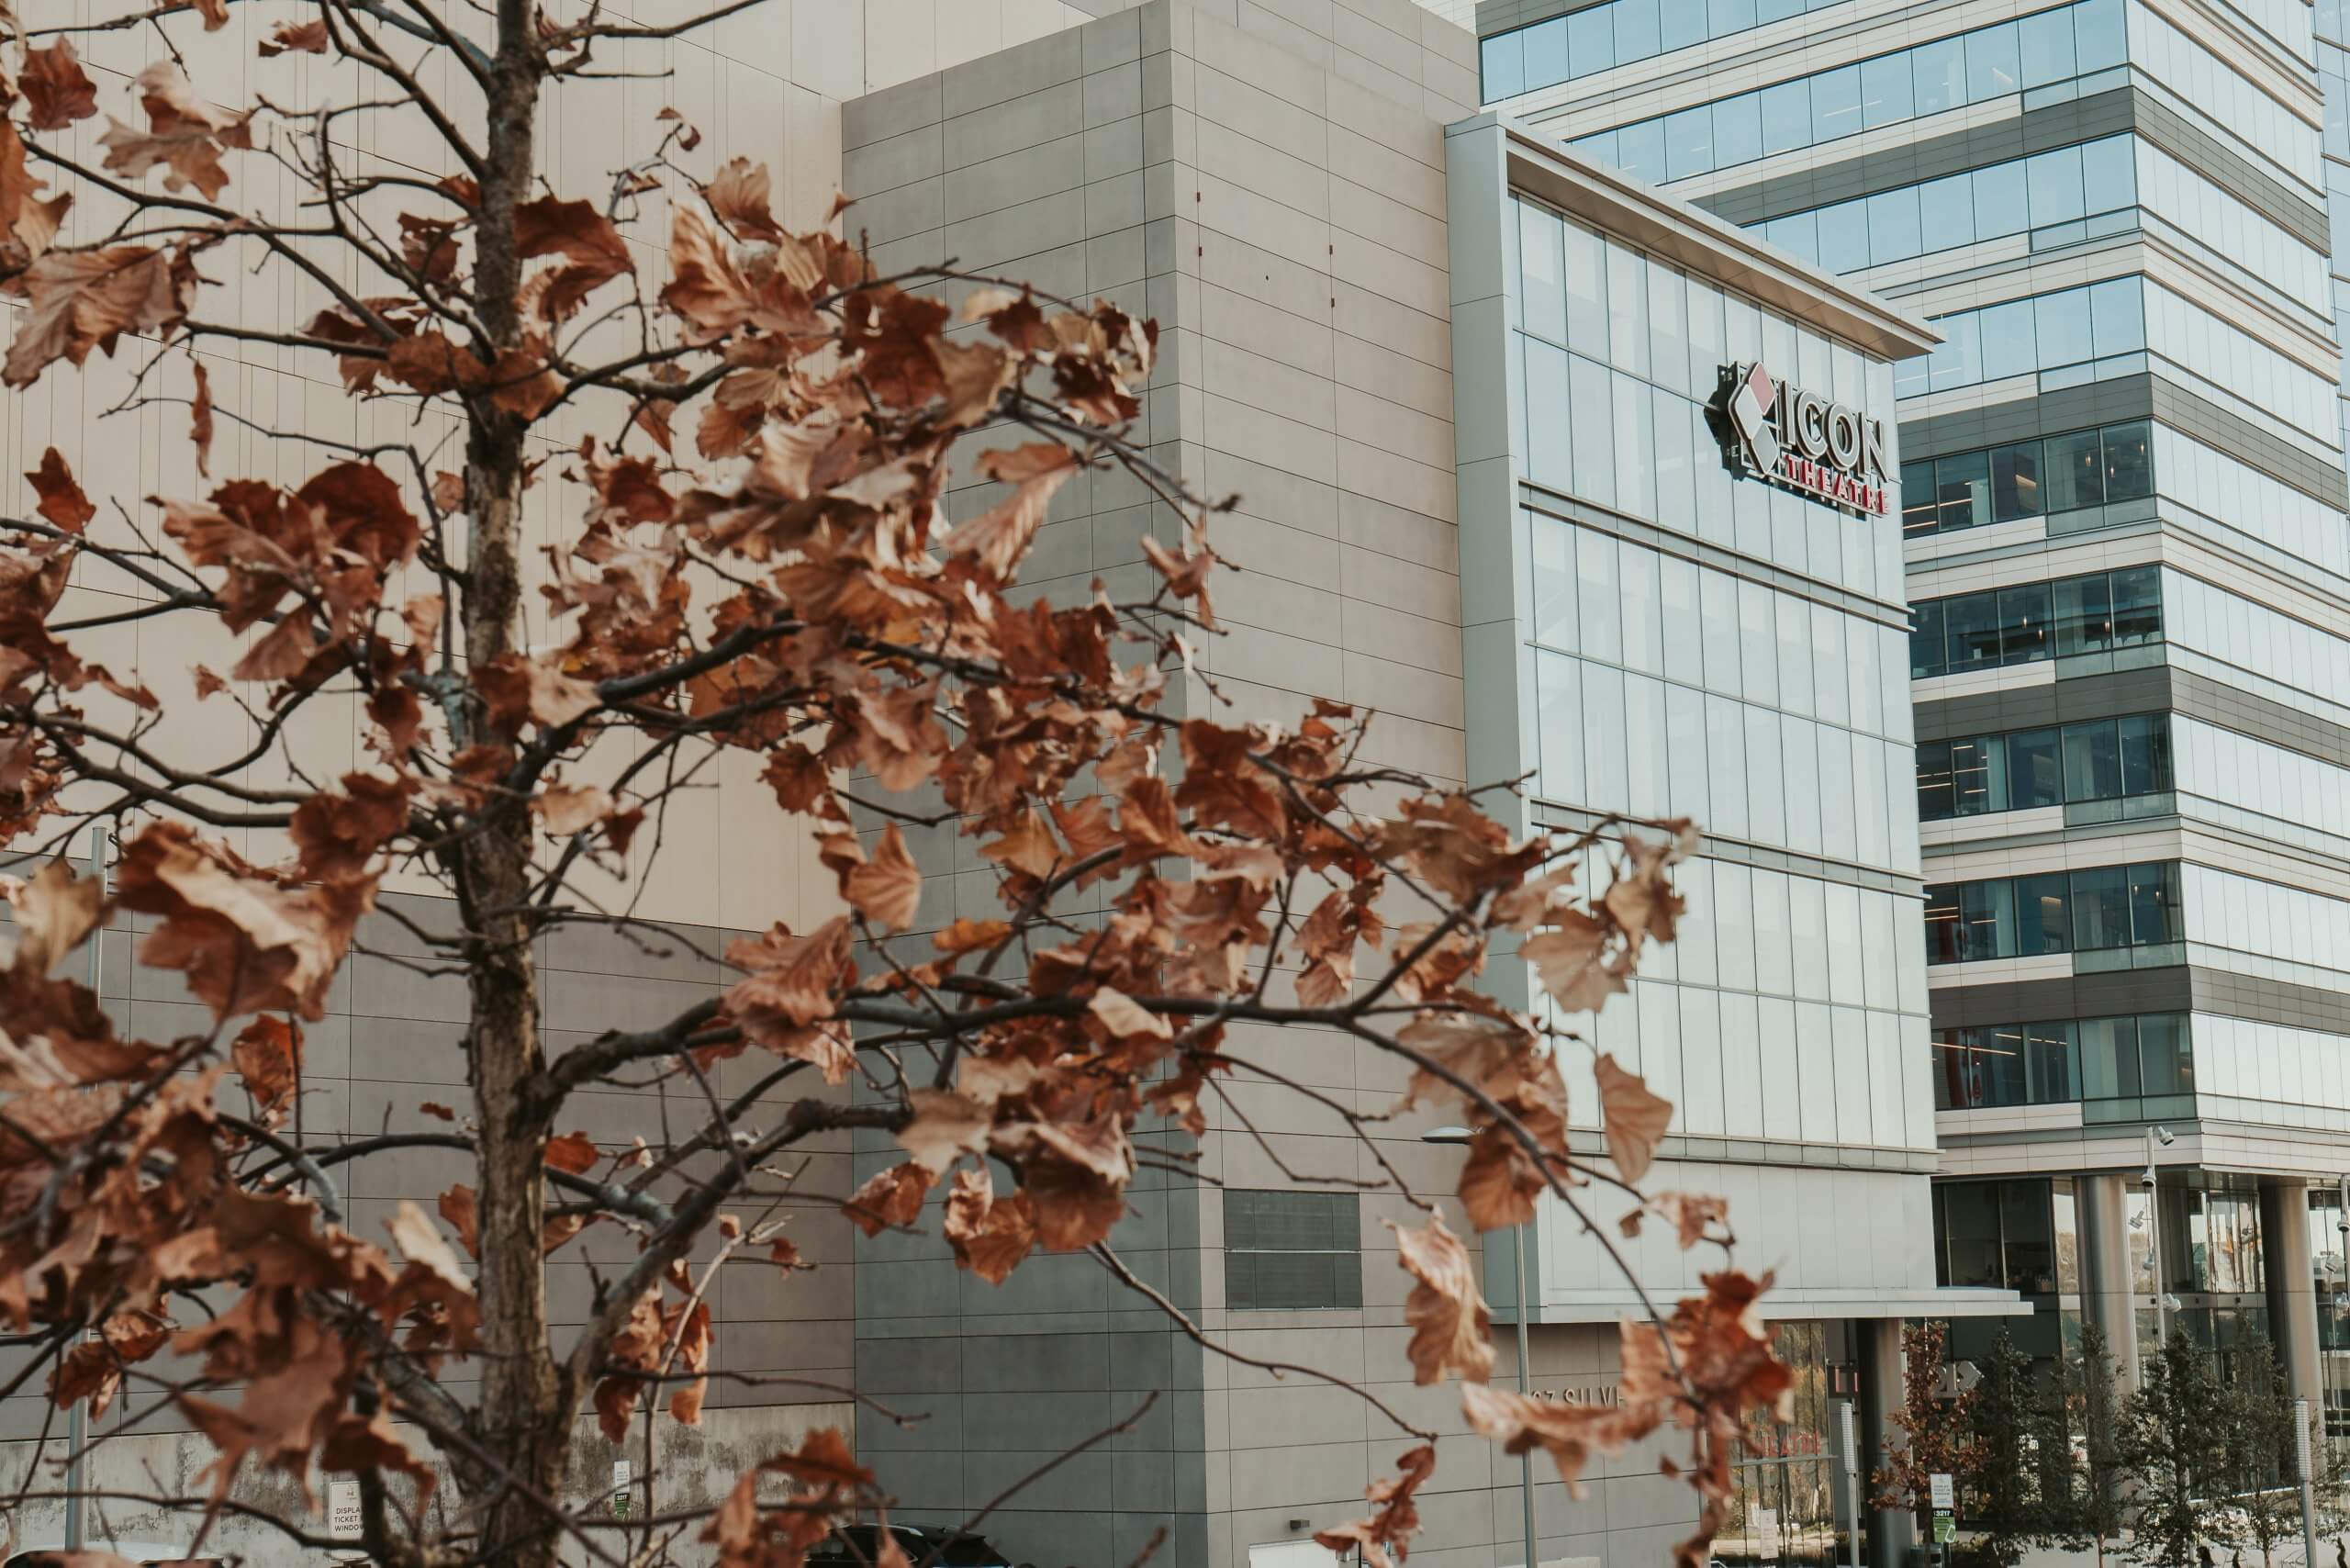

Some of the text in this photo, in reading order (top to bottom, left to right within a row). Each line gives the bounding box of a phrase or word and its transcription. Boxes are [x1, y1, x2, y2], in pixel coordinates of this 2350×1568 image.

[1779, 380, 1888, 483] ICON
[1782, 454, 1888, 515] THEATRE
[334, 1515, 359, 1523] TICKET
